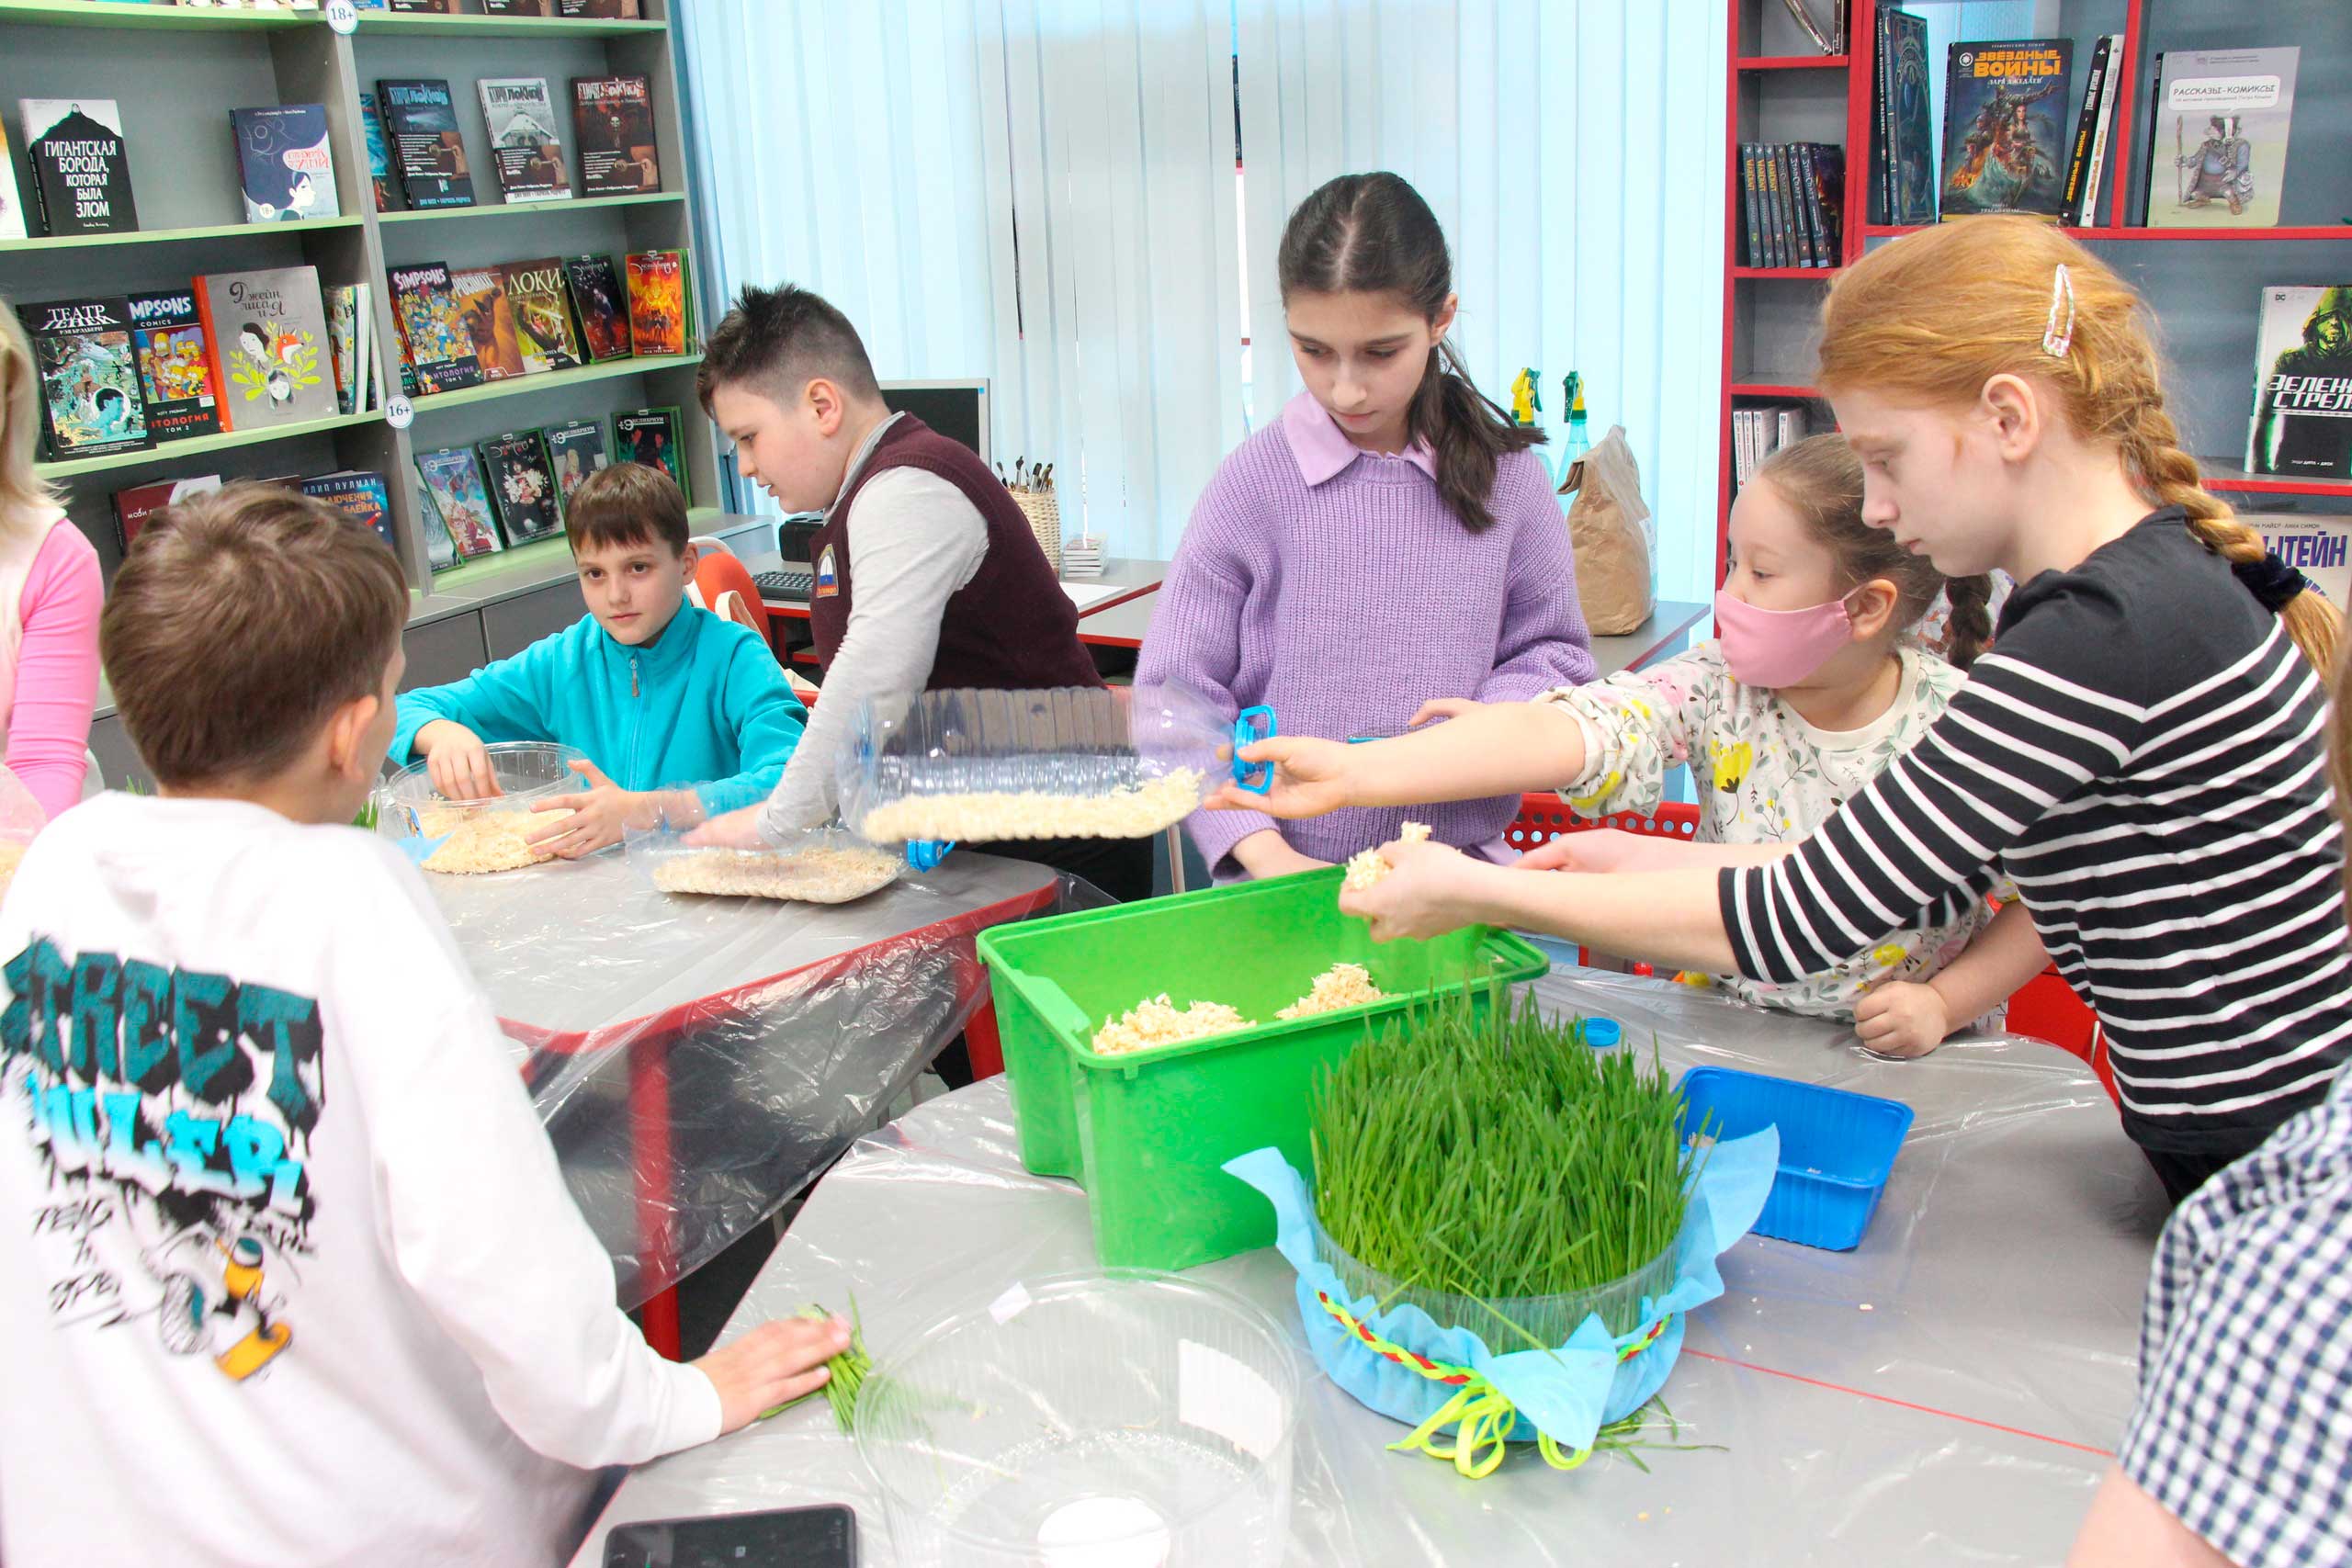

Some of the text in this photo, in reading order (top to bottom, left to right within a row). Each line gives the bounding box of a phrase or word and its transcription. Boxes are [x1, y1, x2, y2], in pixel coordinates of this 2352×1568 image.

[330, 7, 354, 21] 18+
[1973, 59, 2062, 78] ВОЙНЫ
[2173, 85, 2275, 96] РАССКАЗЫ-КОМИКСЫ
[44, 141, 117, 157] ГИГАНТСКАЯ
[59, 156, 109, 173] БОРОДА,
[65, 174, 107, 186] КОТОРАЯ
[76, 188, 103, 201] БЫЛА
[75, 201, 110, 218] ЗЛОМ
[508, 267, 565, 303] ЛОКИ
[47, 304, 106, 321] ТЕАТР
[129, 297, 192, 320] MPSONS
[140, 320, 172, 328] COMICS
[389, 404, 411, 417] 16+
[302, 478, 377, 495] ИЛИП ПУЛМАН
[322, 491, 373, 504] ЛЮЧЕНИЯ
[343, 502, 382, 514] БЛЕЙКА
[26, 1068, 315, 1226] ULER
